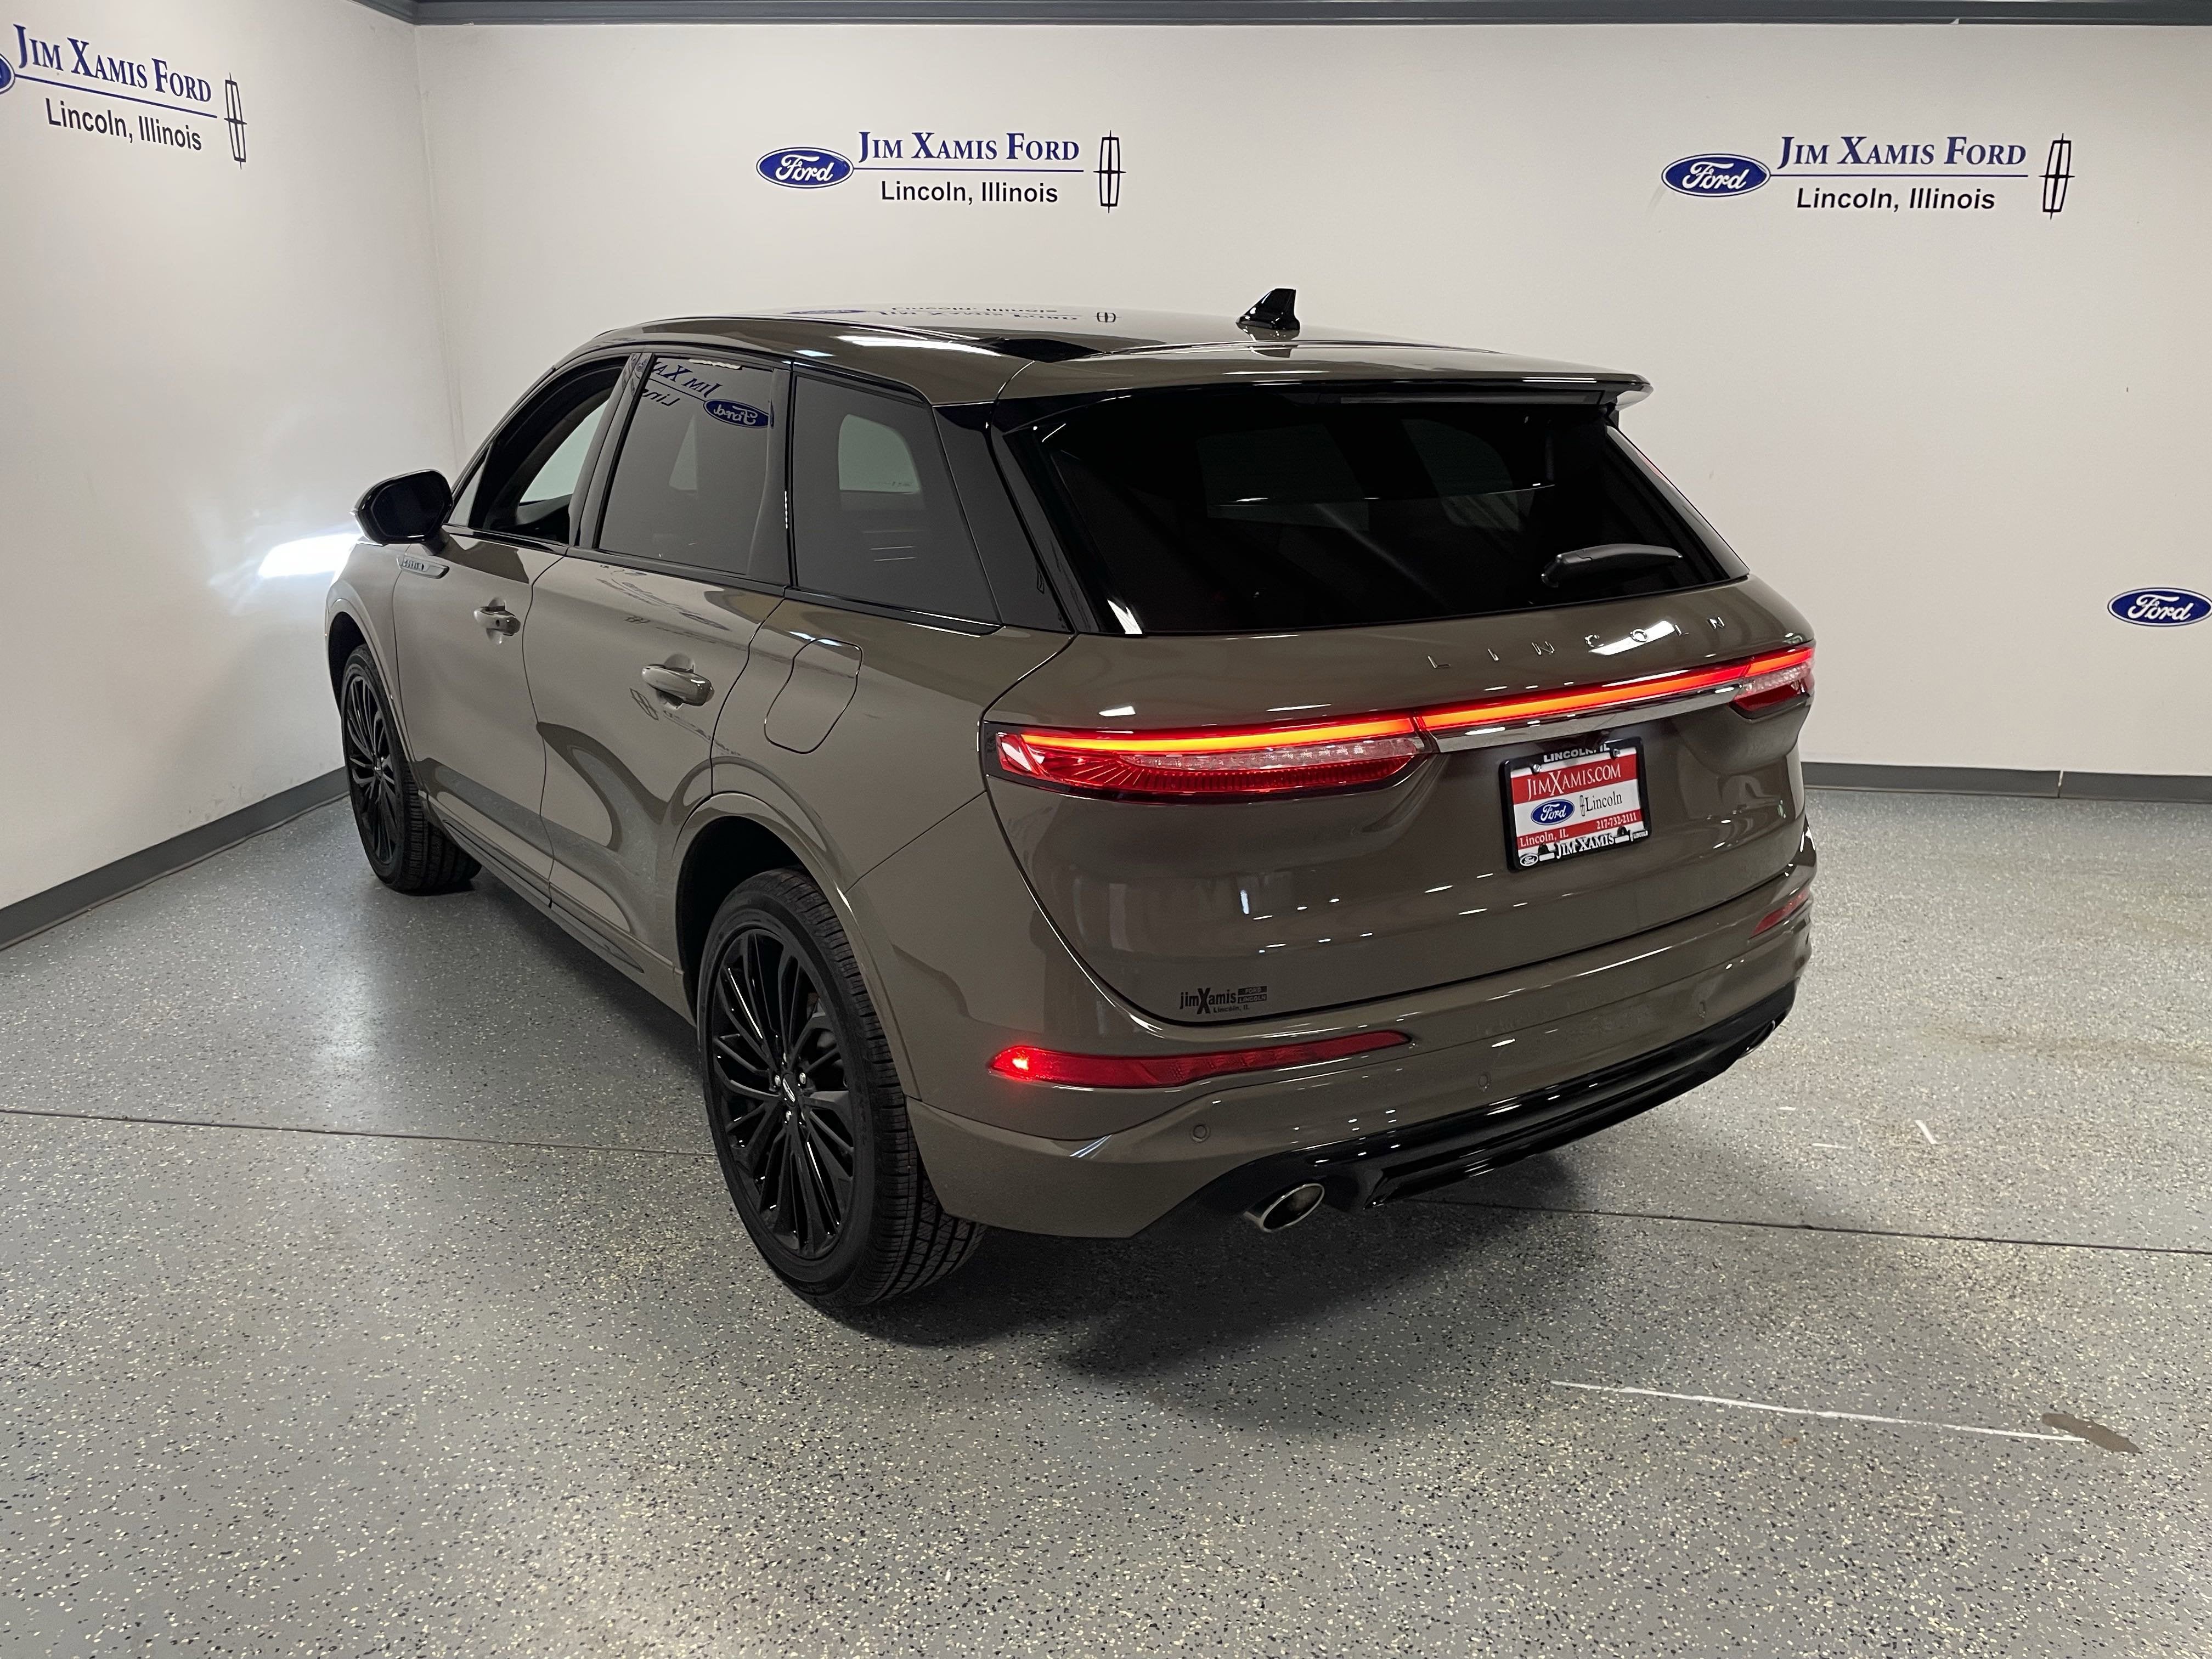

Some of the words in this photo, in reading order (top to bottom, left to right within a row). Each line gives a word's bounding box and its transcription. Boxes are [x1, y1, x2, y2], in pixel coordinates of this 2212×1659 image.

[46, 98, 133, 144] Lincoln,
[138, 115, 202, 151] Illinois
[775, 154, 834, 182] Ford
[1681, 161, 1750, 190] Ford
[881, 180, 973, 205] Lincoln,
[981, 182, 1058, 203] Illinois
[1797, 187, 1899, 212] Lincoln,
[1909, 188, 1995, 209] Illinois
[2128, 594, 2194, 620] Ford
[1428, 616, 1725, 669] LINCOLN
[1599, 743, 1610, 752] IL
[1540, 803, 1567, 821] Ford
[1585, 791, 1623, 812] Lincoln
[1596, 812, 1637, 830] 217-732-2111
[1520, 832, 1557, 847] Lincoln,
[1559, 828, 1569, 839] IL
[1556, 841, 1577, 859] JIM
[1579, 834, 1615, 851] XAMIS
[1180, 988, 1237, 1014] jimXamis
